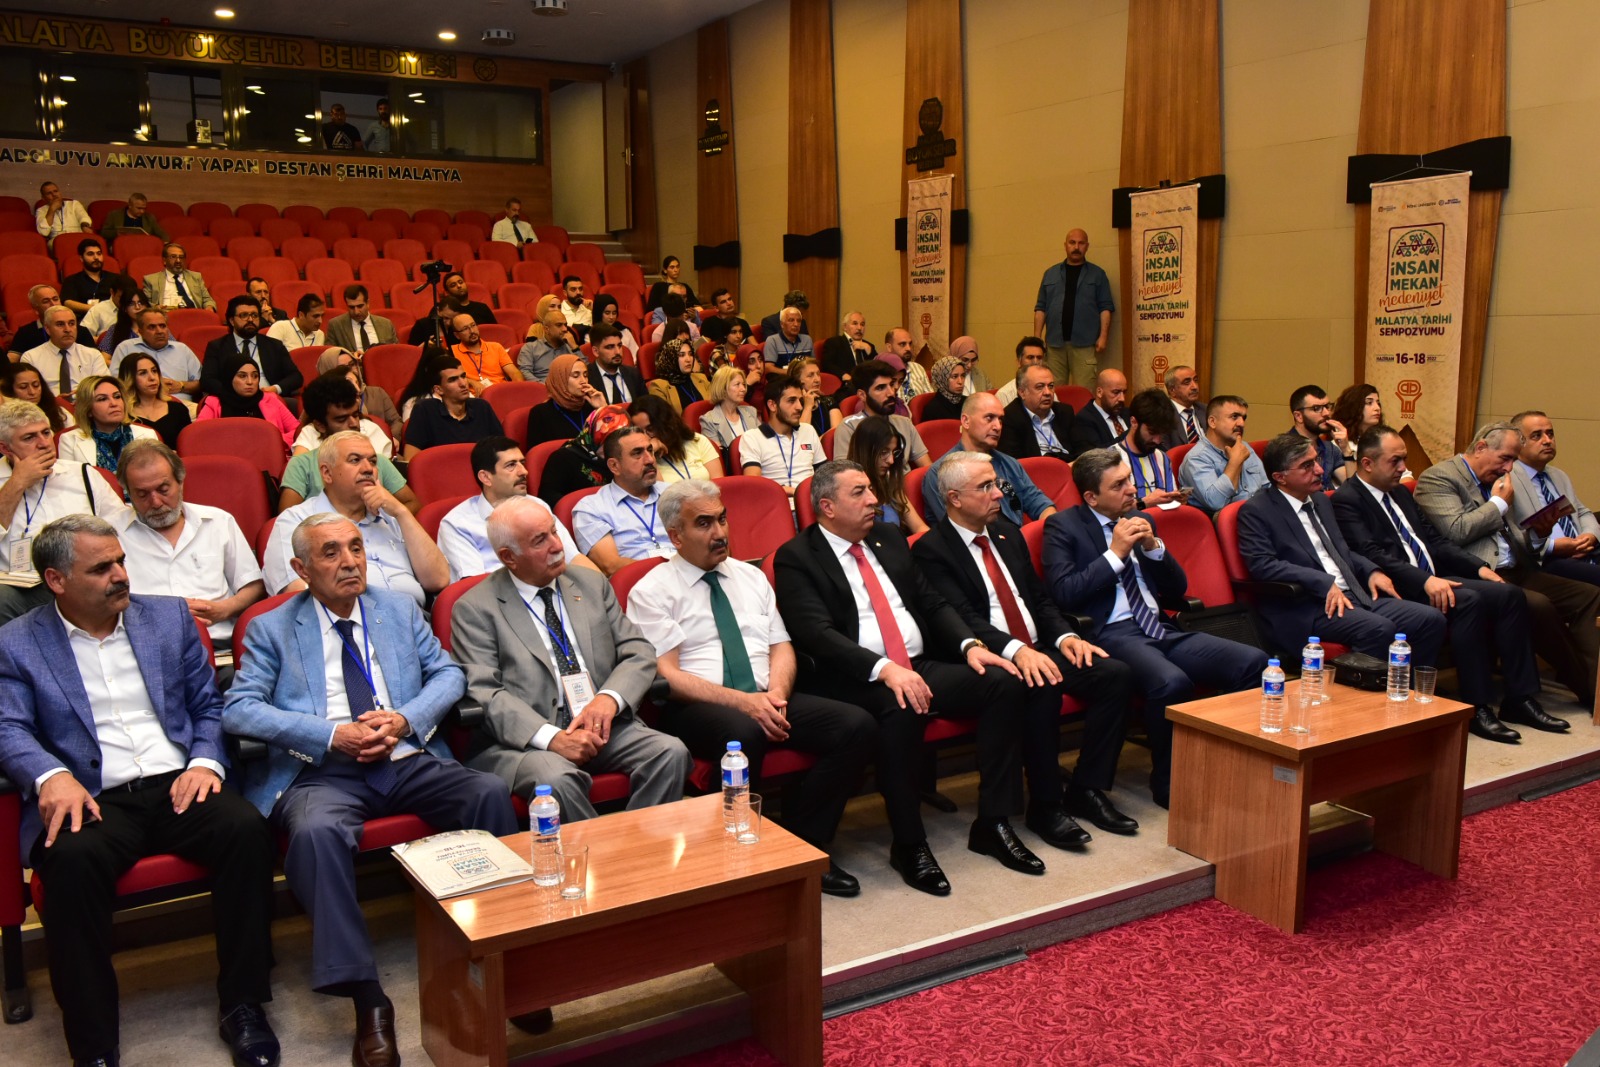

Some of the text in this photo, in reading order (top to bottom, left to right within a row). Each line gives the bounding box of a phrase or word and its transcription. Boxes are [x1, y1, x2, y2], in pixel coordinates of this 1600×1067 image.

[128, 26, 304, 66] BÜYÜKŞEHİR
[320, 44, 458, 79] BELEDİYESİ
[106, 152, 194, 171] ANAYURT
[199, 156, 259, 174] YAPAN
[265, 160, 332, 177] DESTAN
[336, 163, 384, 181] ŞEHRİ
[388, 165, 462, 183] MALATYA
[1146, 271, 1179, 282] MEKAN
[1138, 276, 1184, 297] medeniyet
[1390, 277, 1438, 291] MEKAN
[1379, 283, 1448, 308] medeniyet
[1136, 301, 1189, 311] MALATYA TARİHİ
[1140, 311, 1184, 320] SEMPOZYUMU
[1375, 313, 1452, 326] MALATYA TARİHİ
[1379, 327, 1445, 336] SEMPOZYUMU
[1151, 333, 1171, 343] 16-18
[1395, 353, 1426, 364] 16-18
